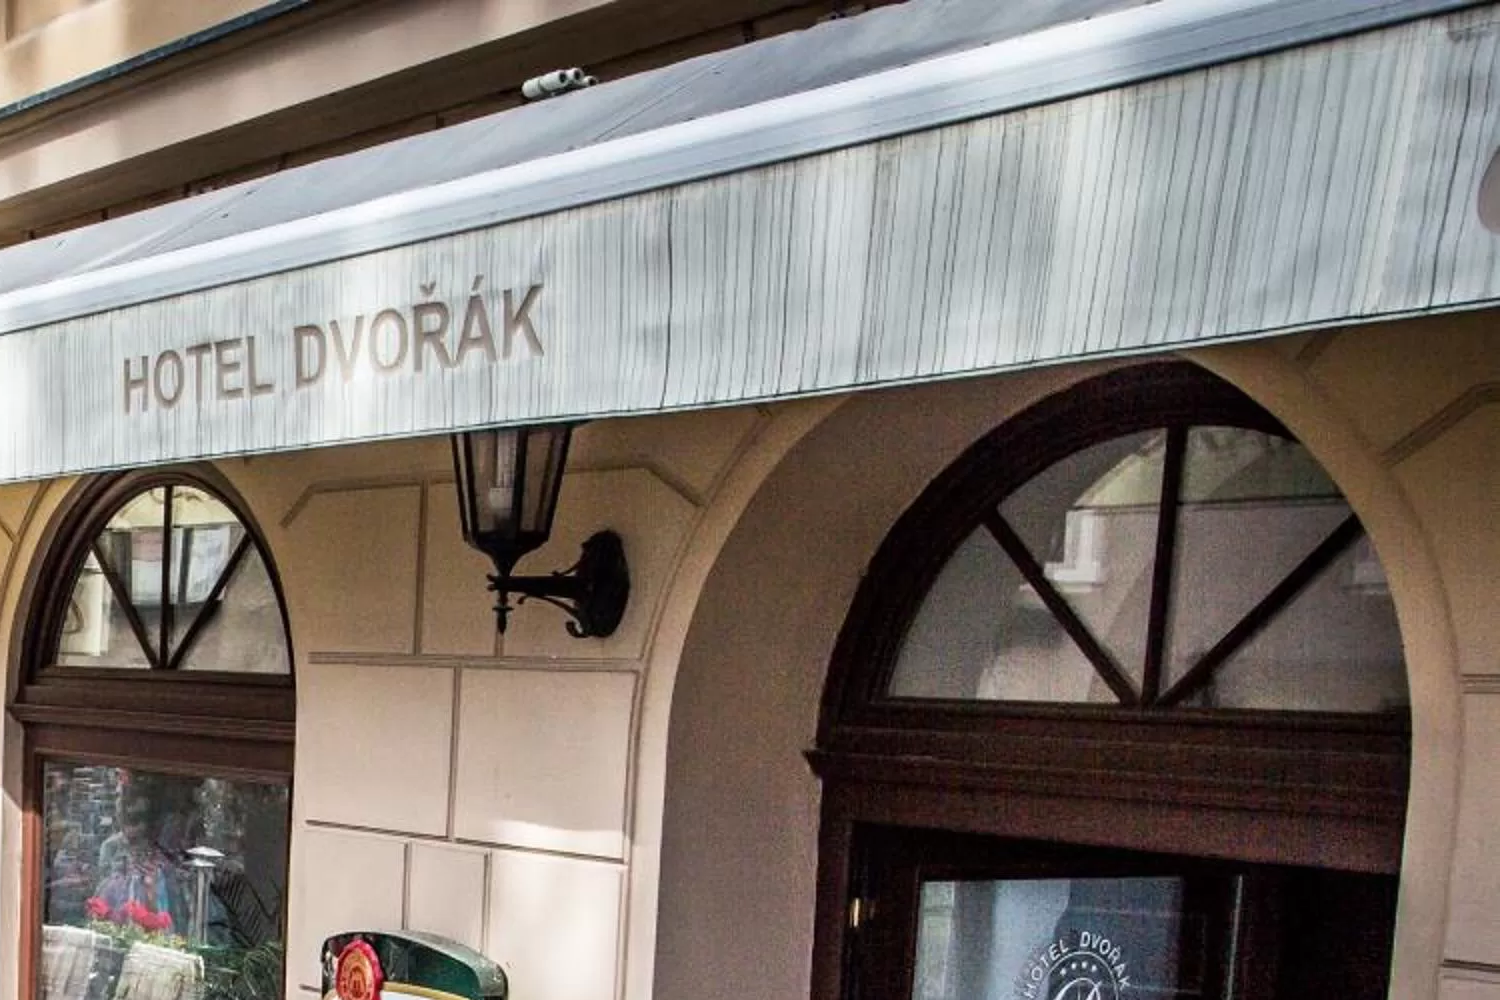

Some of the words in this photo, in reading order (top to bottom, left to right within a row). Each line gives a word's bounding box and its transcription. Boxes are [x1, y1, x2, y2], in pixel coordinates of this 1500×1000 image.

[123, 335, 275, 415] HOTEL
[292, 272, 546, 391] DVOŘÁK
[1024, 939, 1069, 999] HOTEL
